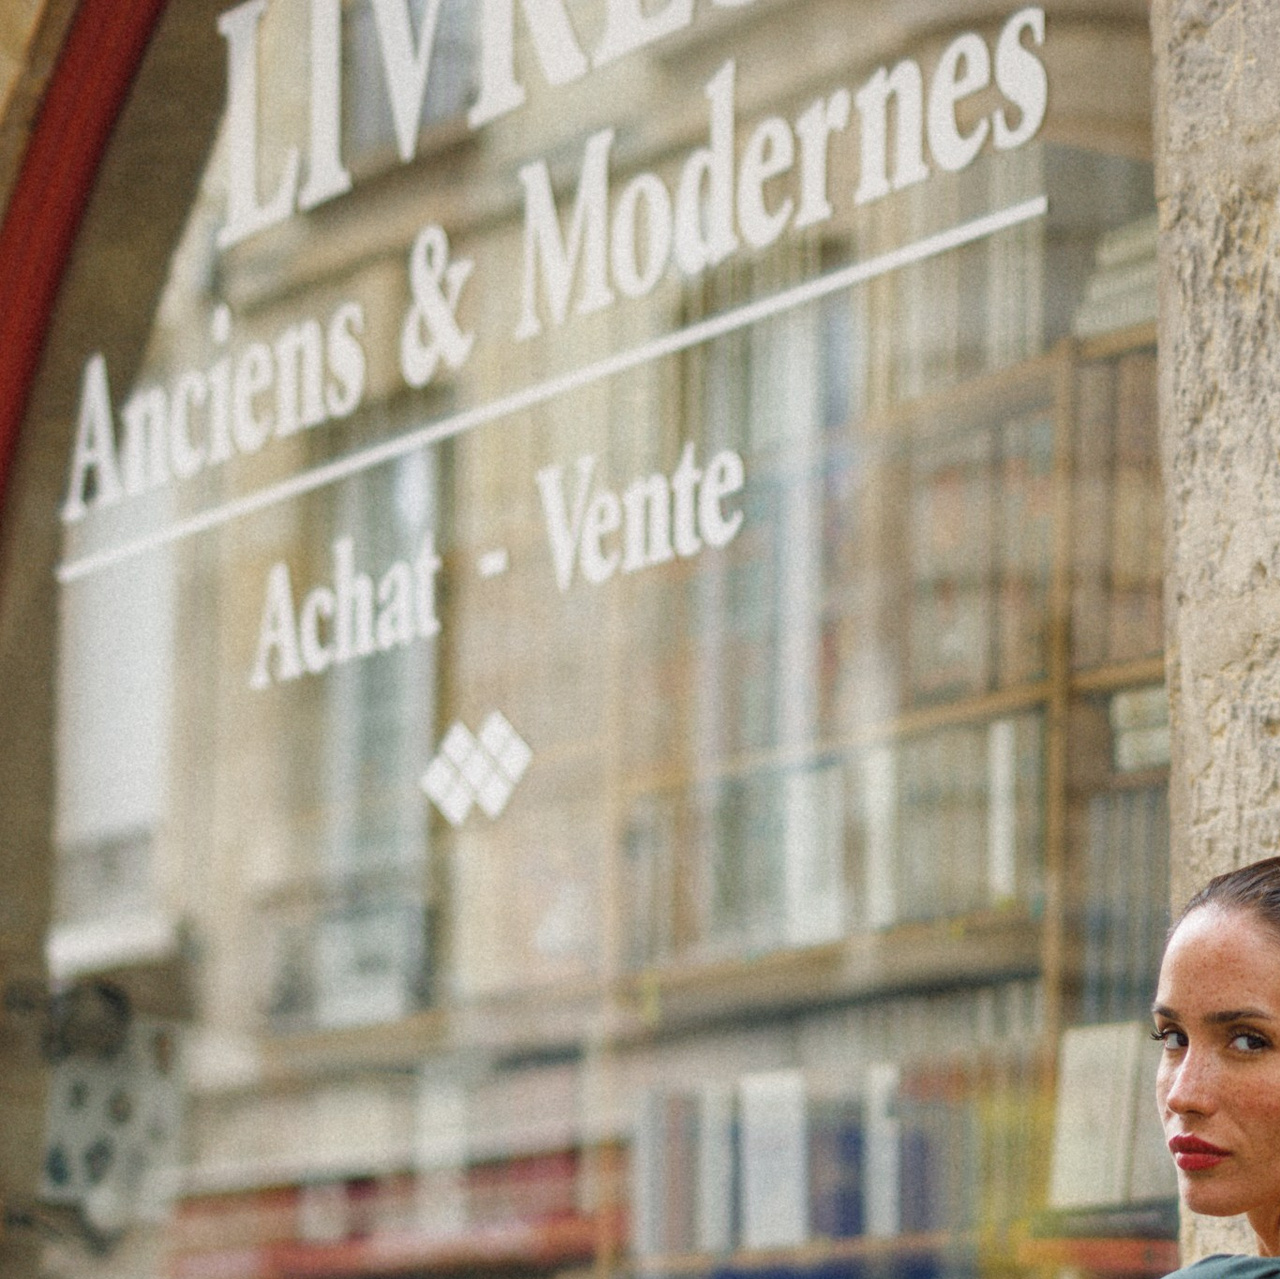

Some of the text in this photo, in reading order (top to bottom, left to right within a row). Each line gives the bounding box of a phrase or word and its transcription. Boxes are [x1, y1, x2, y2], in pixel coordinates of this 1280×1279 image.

[217, 0, 757, 250] LIVR
[60, 7, 1048, 523] Anciens & Modernes
[250, 441, 744, 690] Achat - Vente
